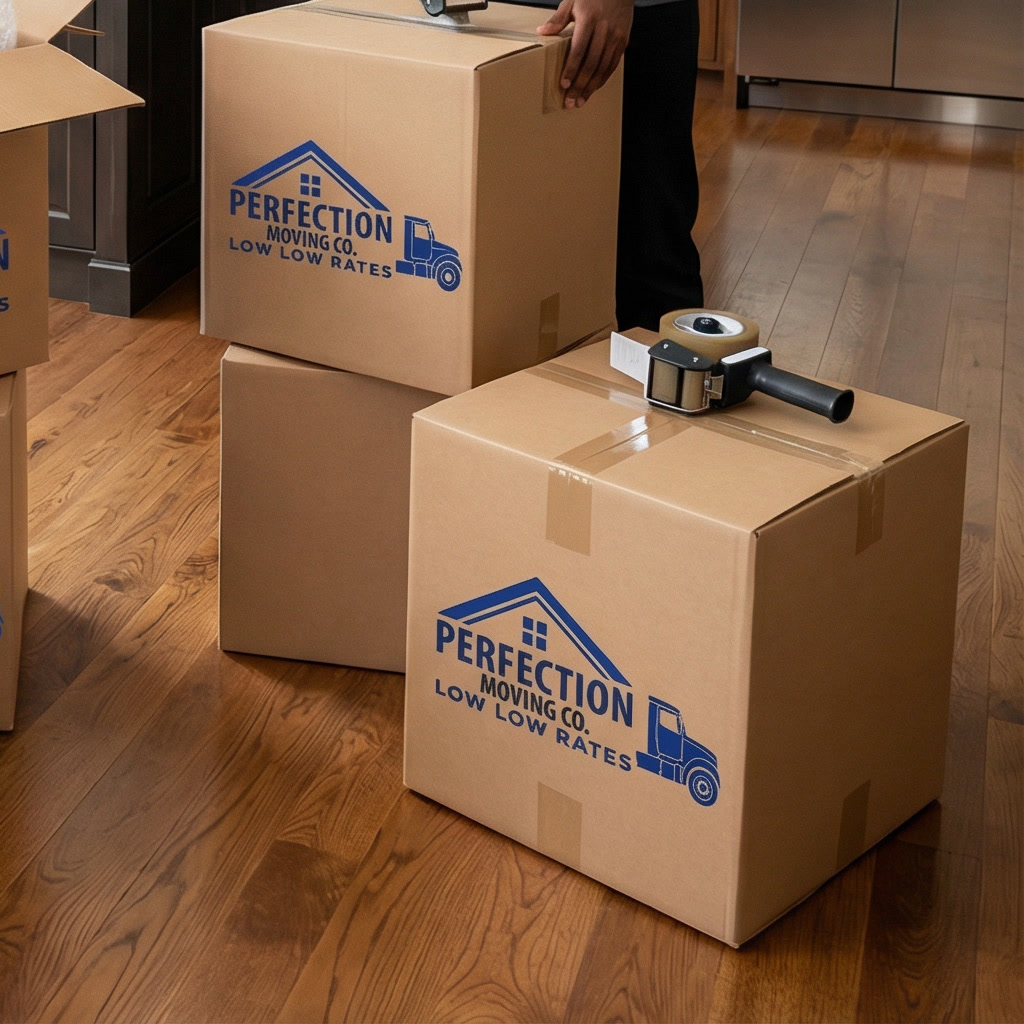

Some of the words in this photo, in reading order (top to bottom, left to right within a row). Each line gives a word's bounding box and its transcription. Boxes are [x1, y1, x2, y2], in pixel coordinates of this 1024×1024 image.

[229, 188, 392, 243] PERFECTION
[267, 225, 329, 251] MOVING
[334, 237, 357, 256] CO.
[229, 237, 272, 256] LOW
[280, 246, 323, 265] LOW
[331, 256, 392, 278] RATES
[436, 618, 633, 728] PERFECTION
[435, 678, 486, 712] LOW
[495, 702, 547, 736] LOW
[556, 727, 632, 772] RATES
[480, 673, 556, 721] MOVING
[561, 706, 590, 735] CO.
